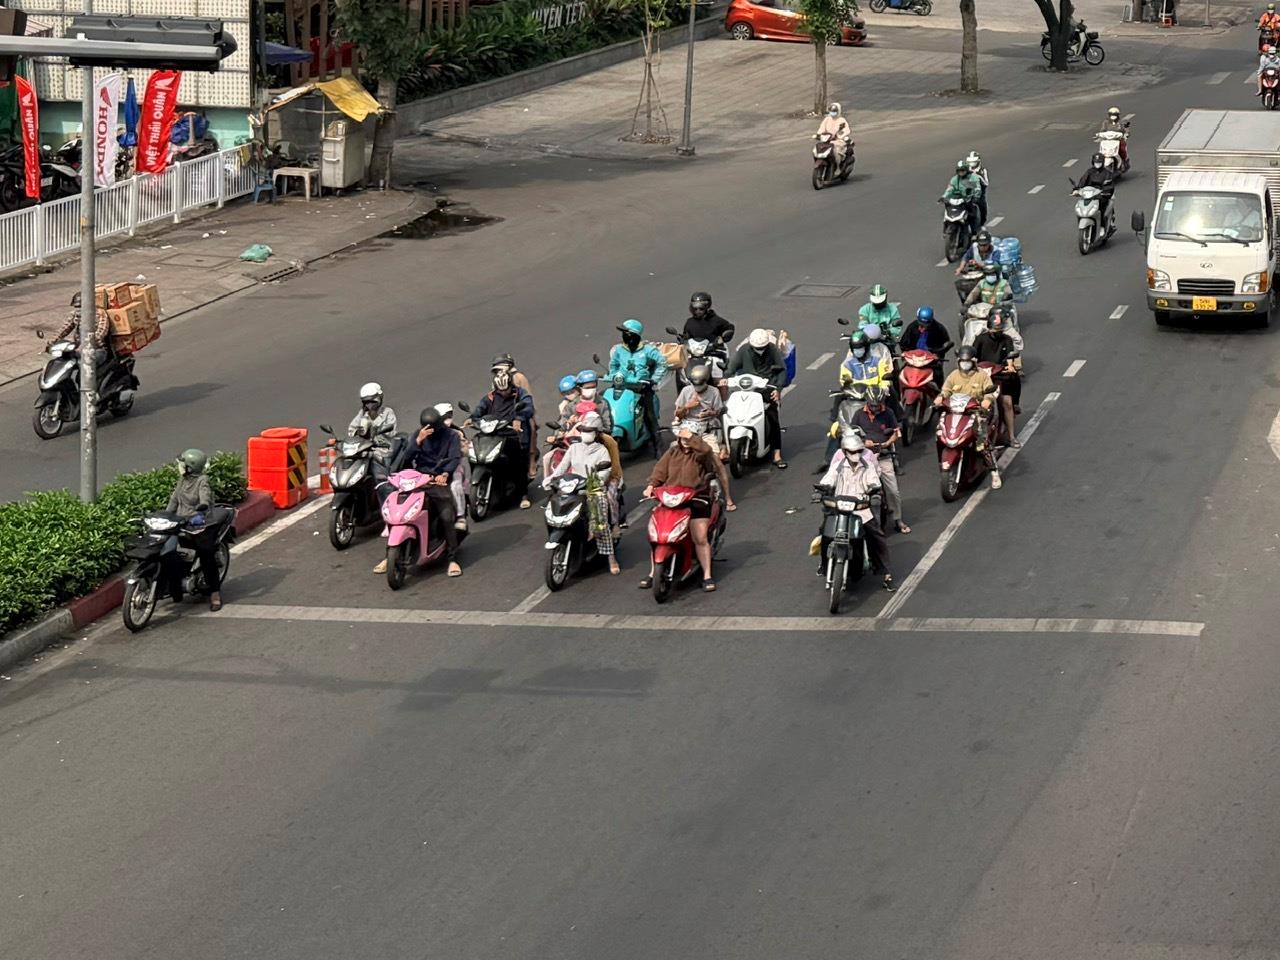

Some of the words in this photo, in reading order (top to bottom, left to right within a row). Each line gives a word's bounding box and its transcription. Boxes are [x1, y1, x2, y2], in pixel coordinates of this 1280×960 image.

[153, 91, 167, 118] QUÂN
[97, 106, 108, 178] HONDA
[148, 122, 162, 143] THÁI
[145, 146, 161, 166] VIỆT
